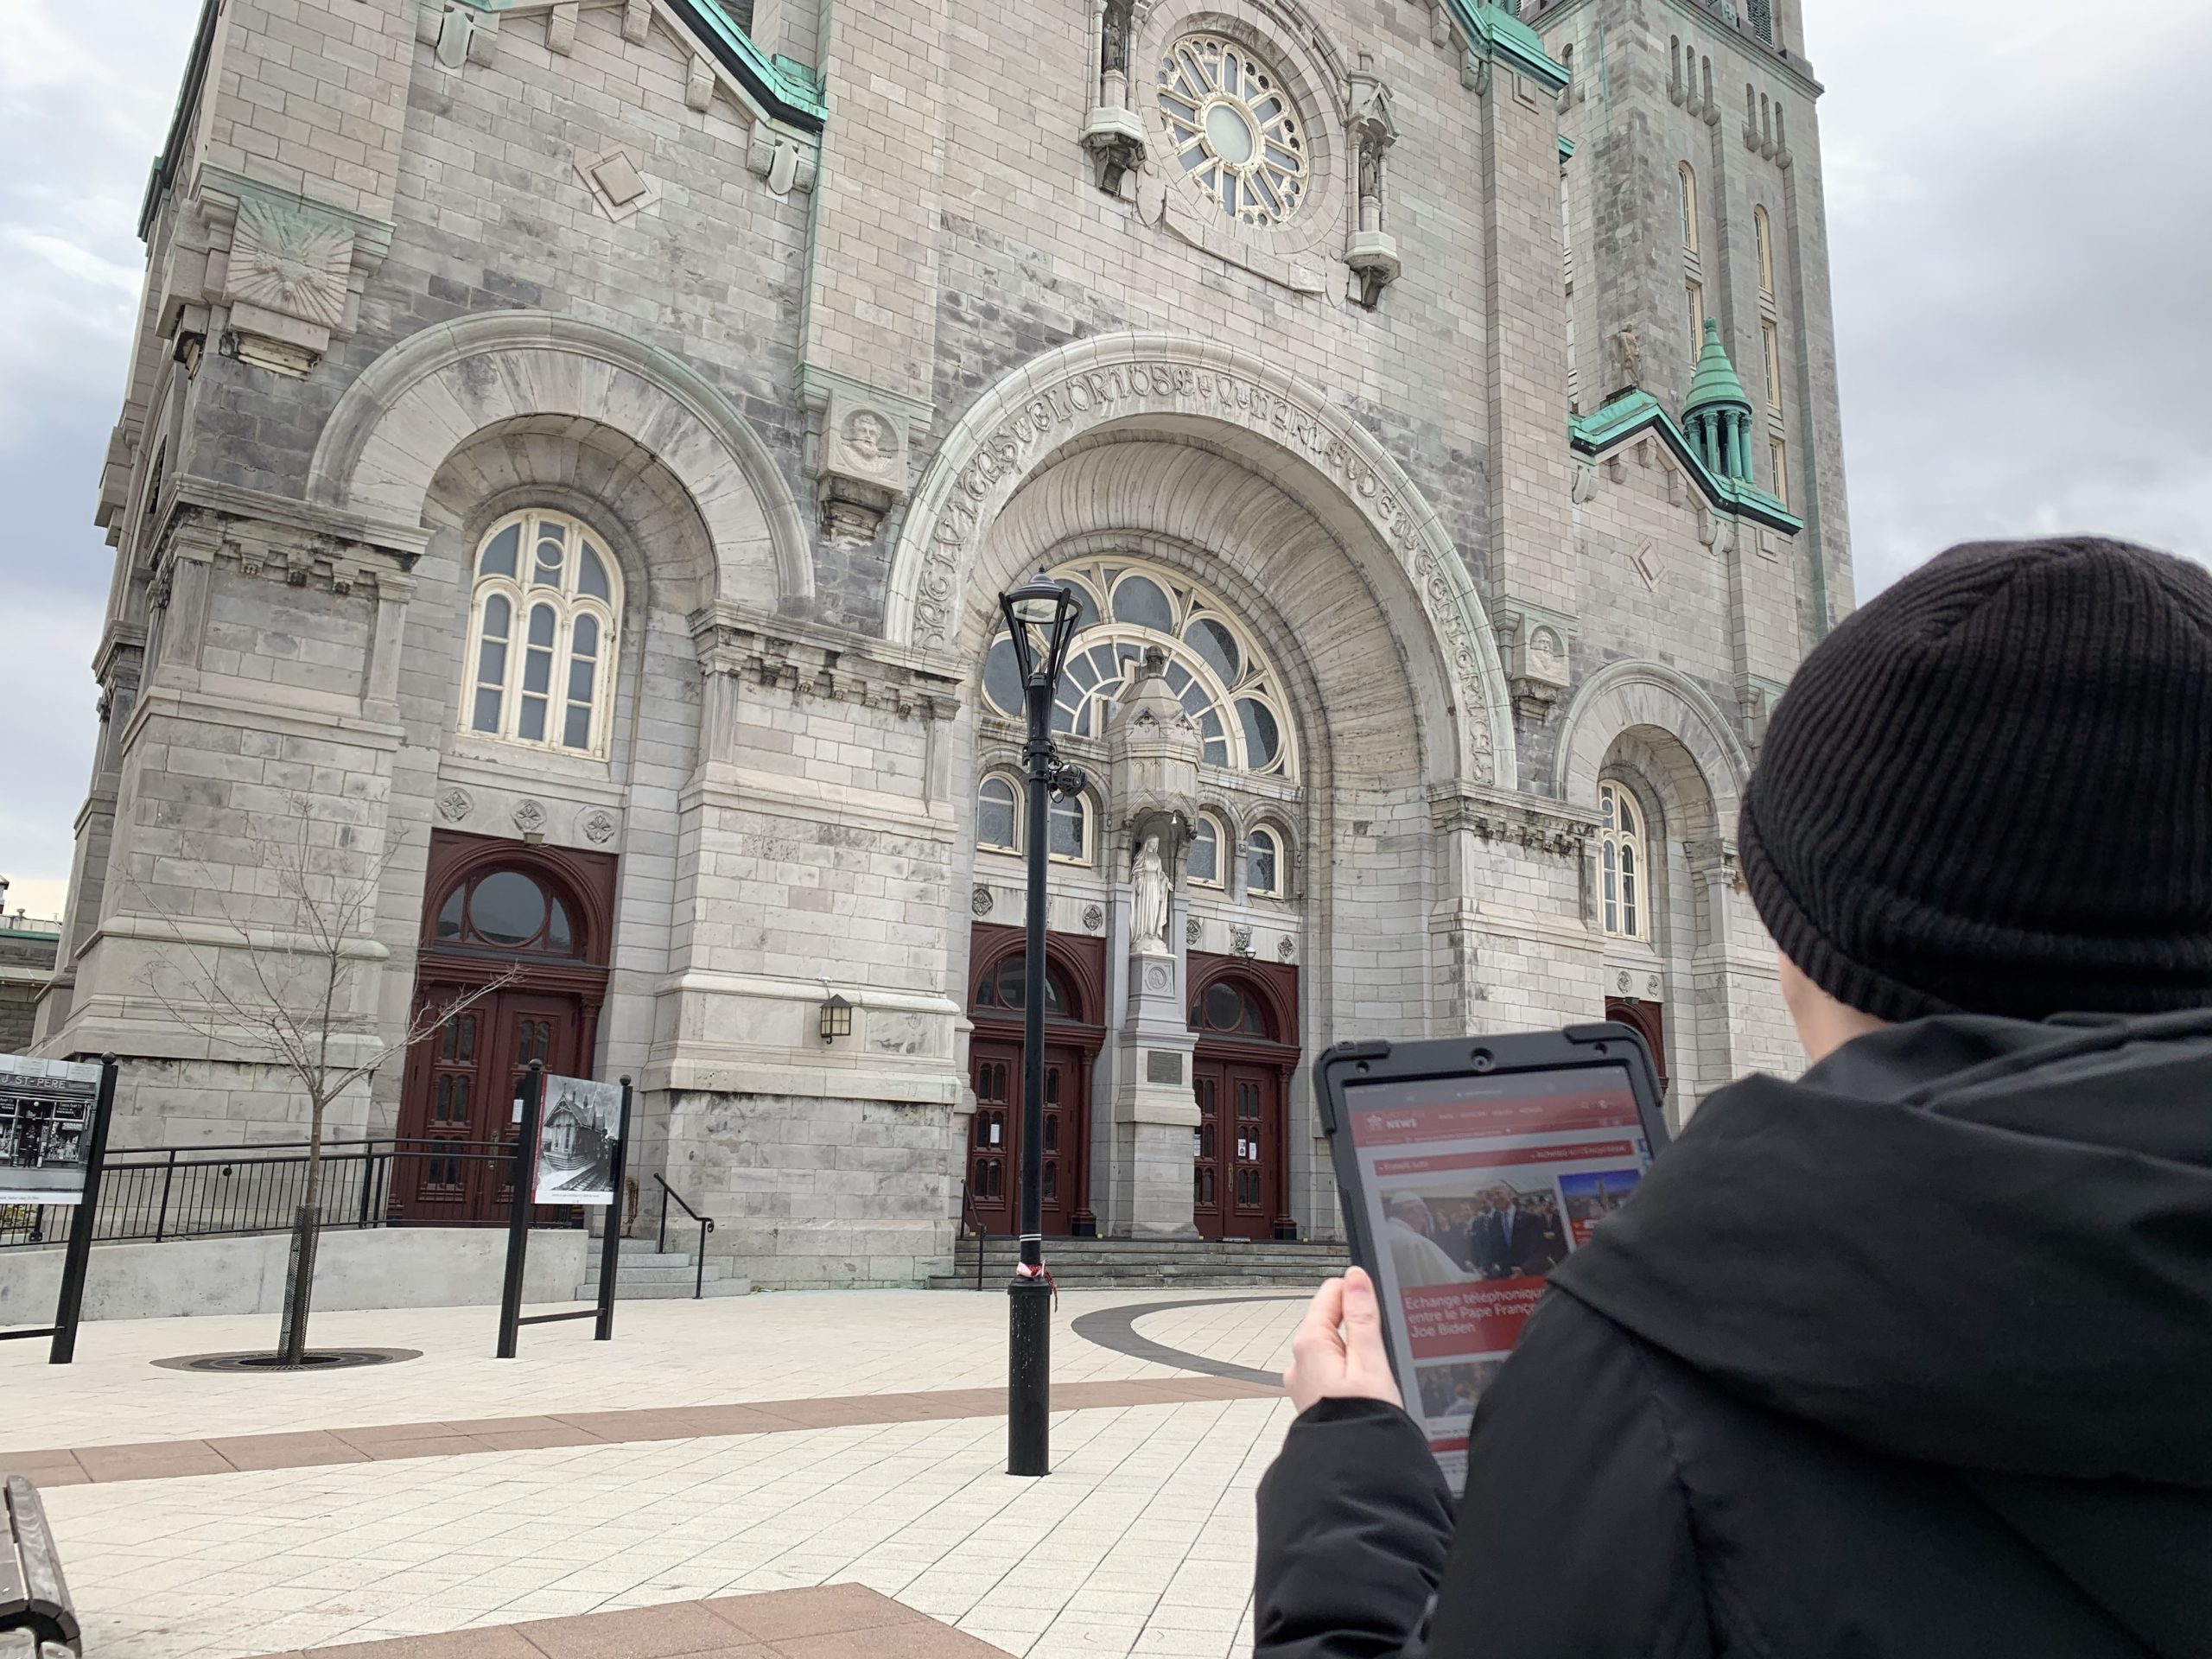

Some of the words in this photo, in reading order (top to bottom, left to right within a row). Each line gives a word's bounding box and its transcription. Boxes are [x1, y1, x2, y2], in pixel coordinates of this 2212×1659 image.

[1386, 1118, 1417, 1129] NEWS
[1408, 1310, 1443, 1324] entre
[1444, 1308, 1457, 1320] le
[1460, 1305, 1493, 1320] Pape
[1410, 1325, 1436, 1338] Joe
[1438, 1322, 1476, 1336] Biden
